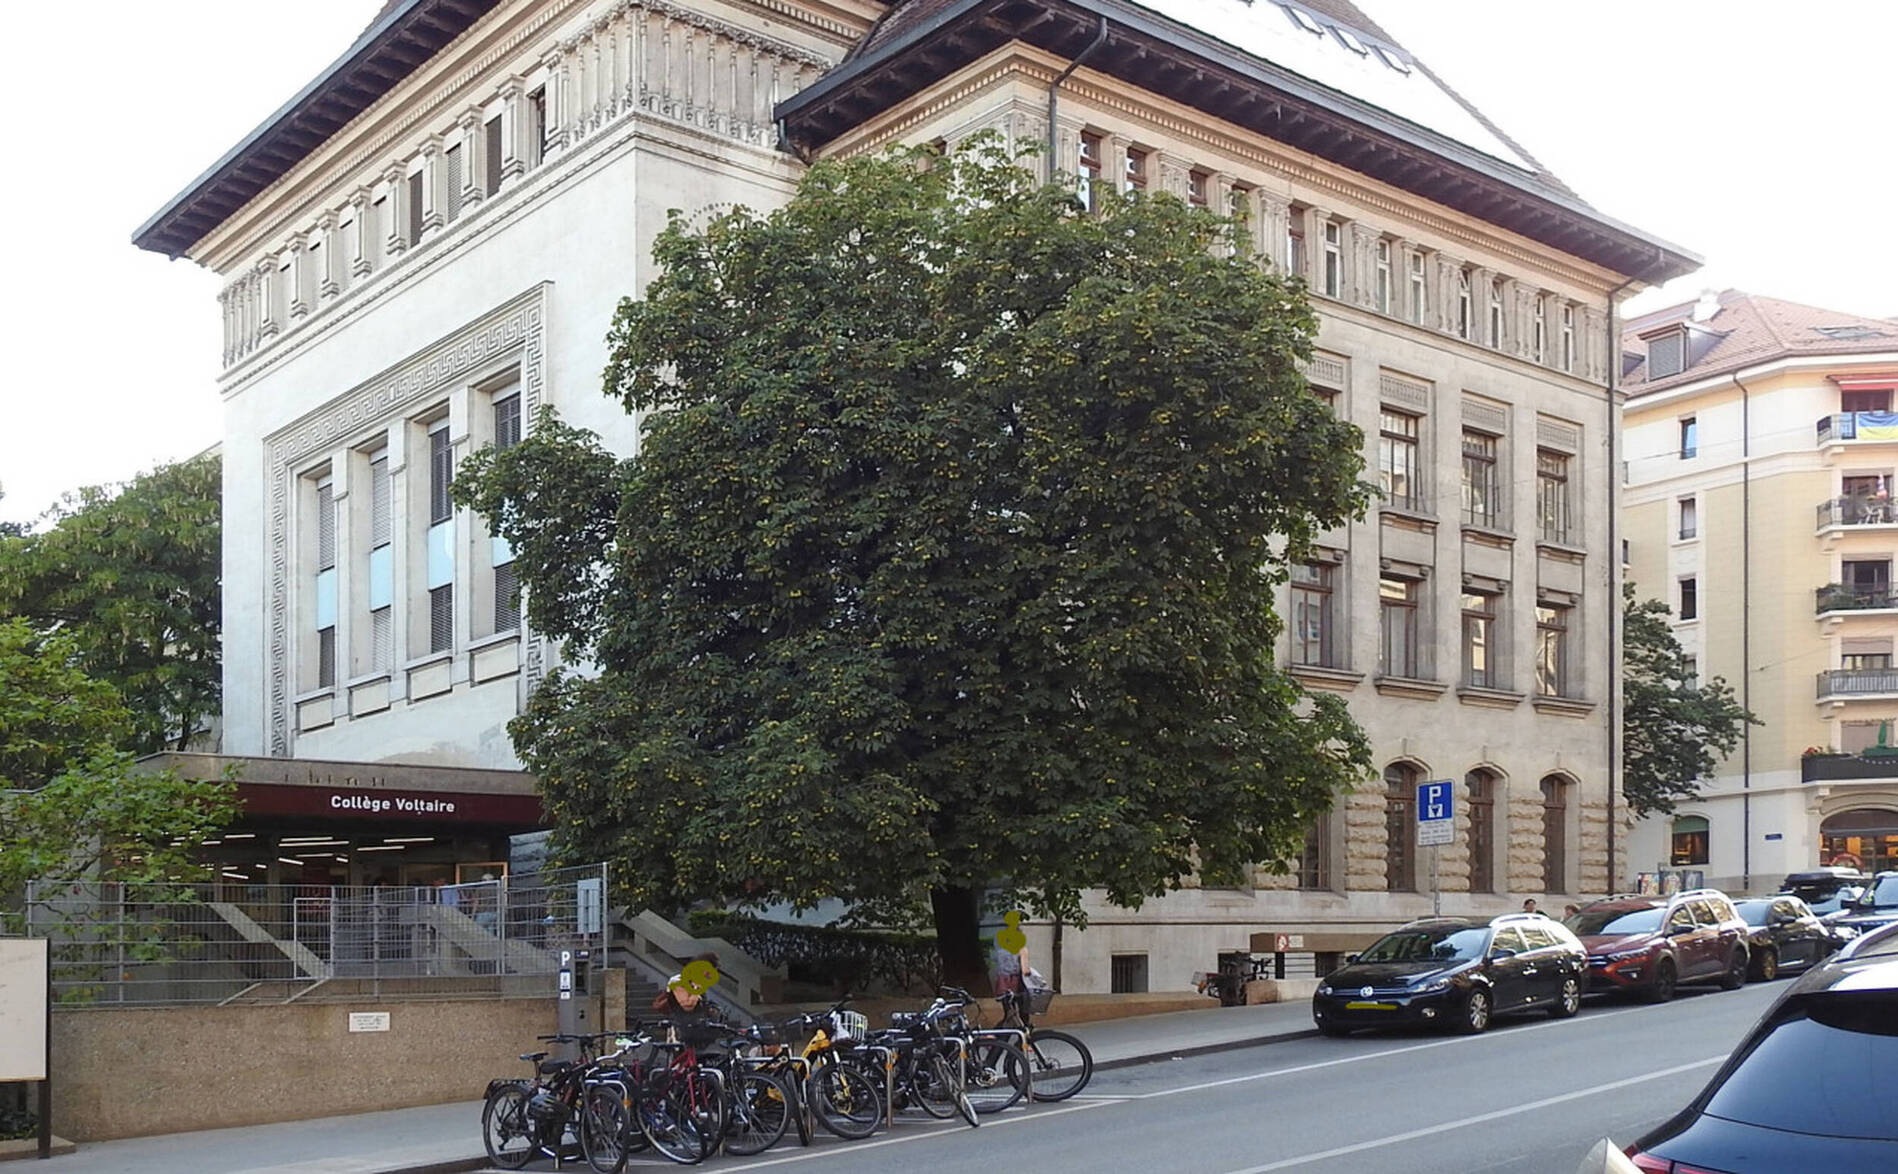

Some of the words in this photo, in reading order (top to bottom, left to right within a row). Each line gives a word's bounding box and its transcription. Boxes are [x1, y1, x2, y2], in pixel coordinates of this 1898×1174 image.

[331, 795, 391, 812] Collège
[396, 798, 455, 812] Voltaire
[1429, 786, 1442, 804] P
[561, 951, 571, 967] P
